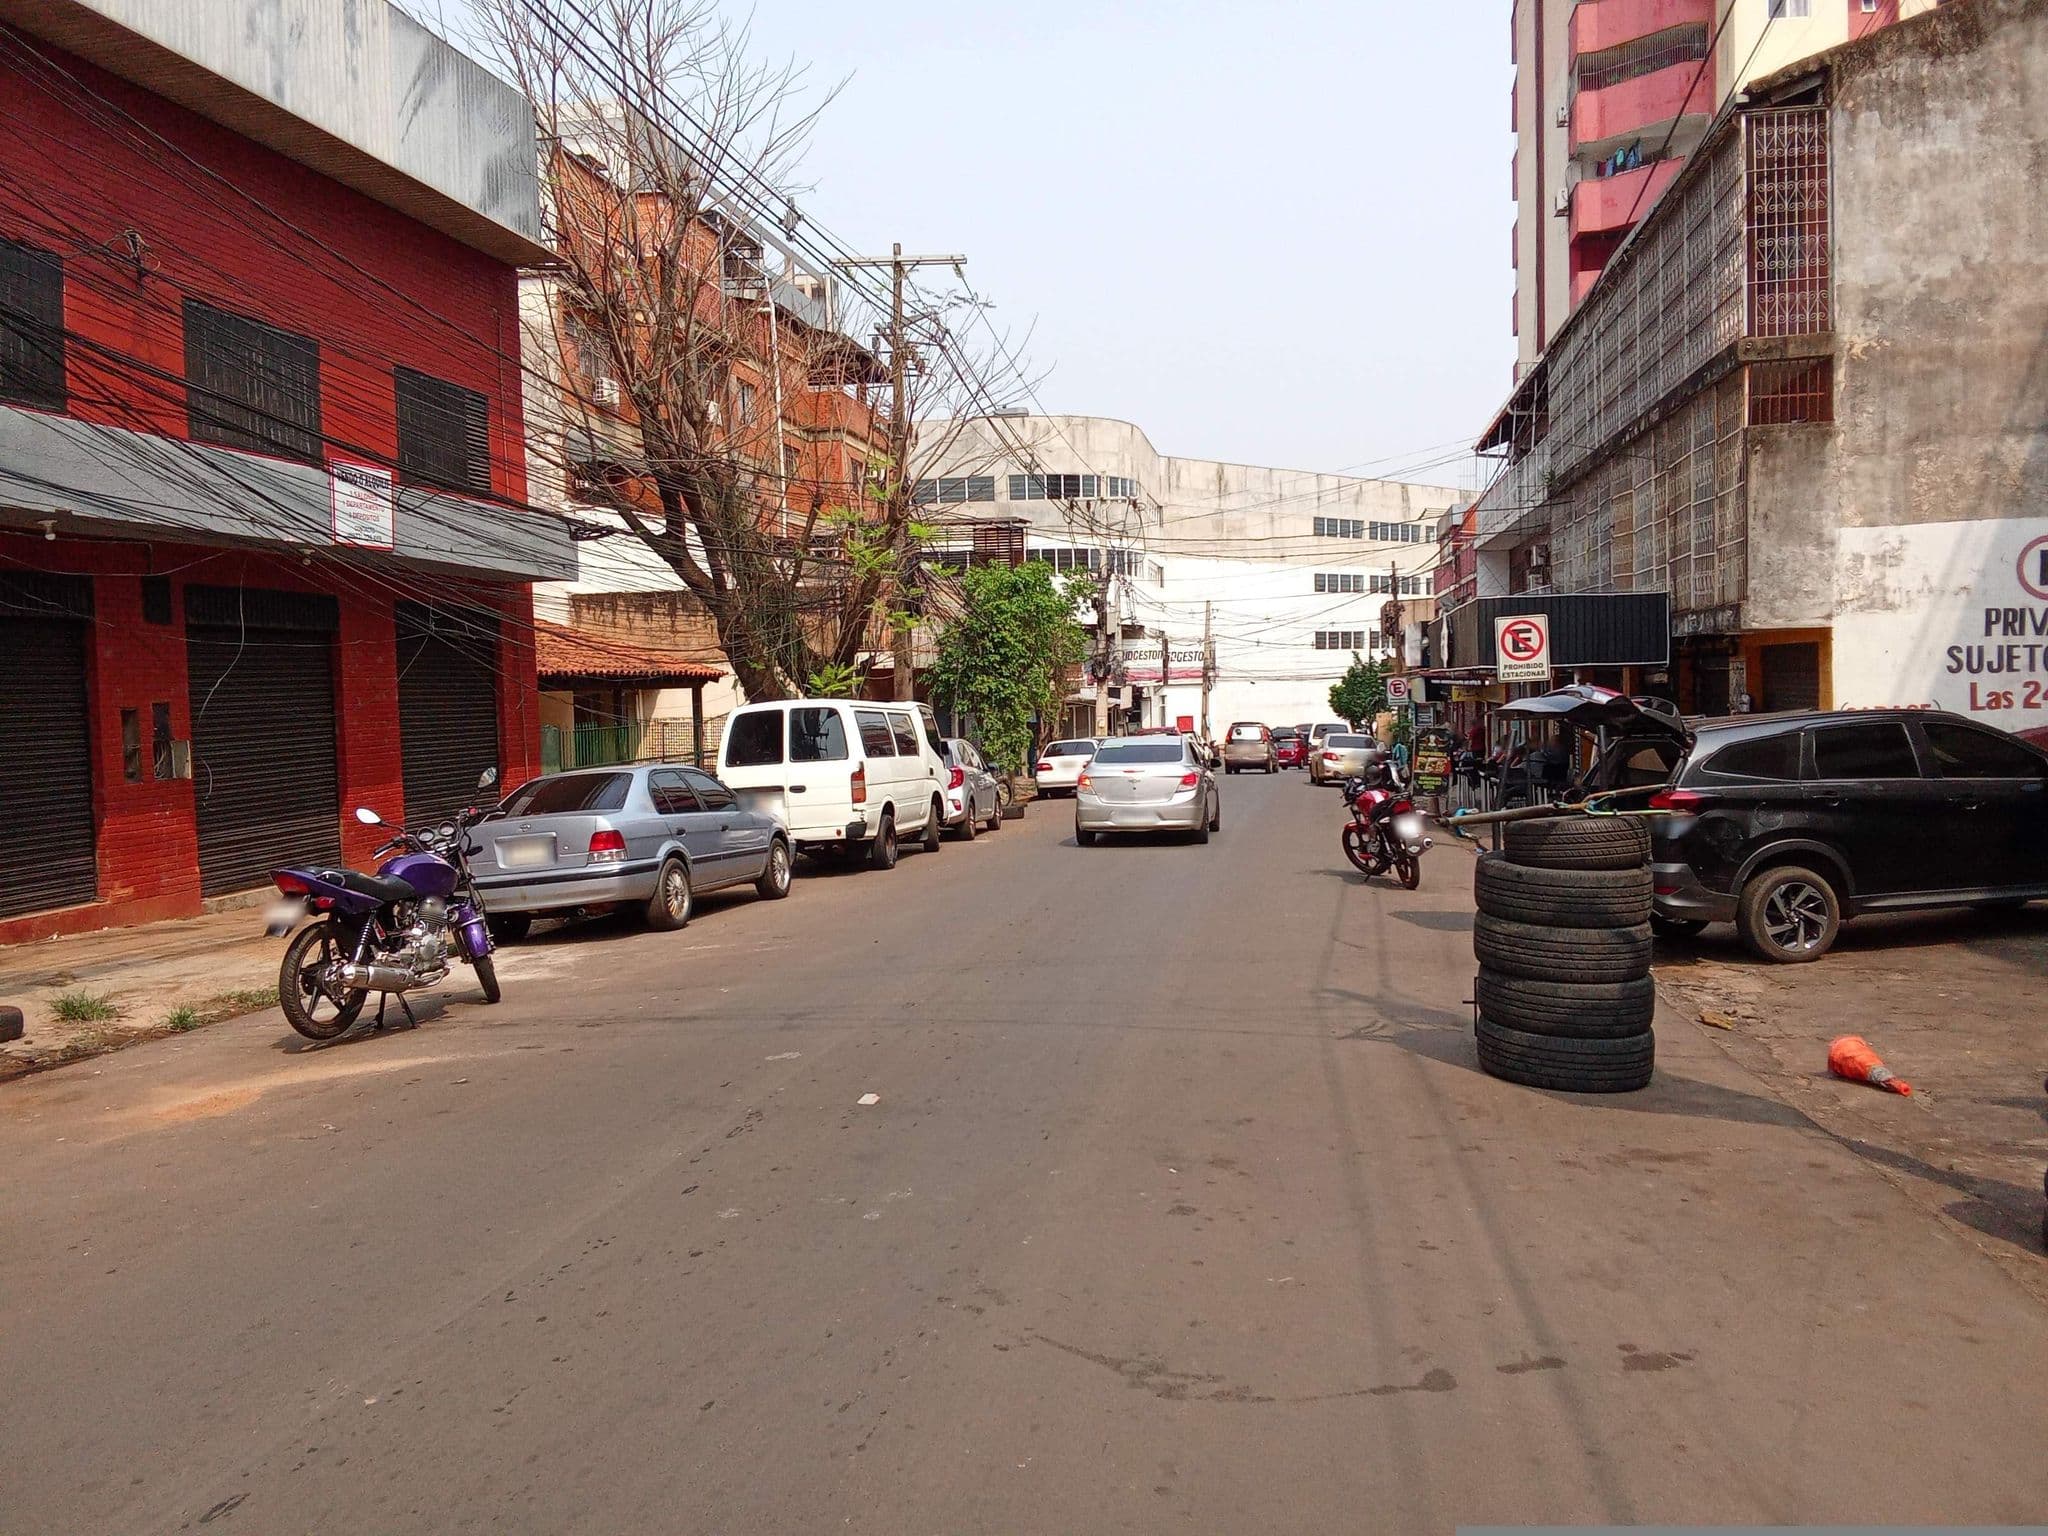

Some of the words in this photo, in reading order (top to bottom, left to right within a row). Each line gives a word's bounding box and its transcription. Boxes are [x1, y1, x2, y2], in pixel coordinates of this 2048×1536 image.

[1984, 607, 2048, 637] PRIV
[1511, 628, 1537, 653] E
[1502, 670, 1546, 679] ESTACIONAR
[1503, 662, 1544, 670] PROHIBIDO
[1969, 682, 2015, 711] Las
